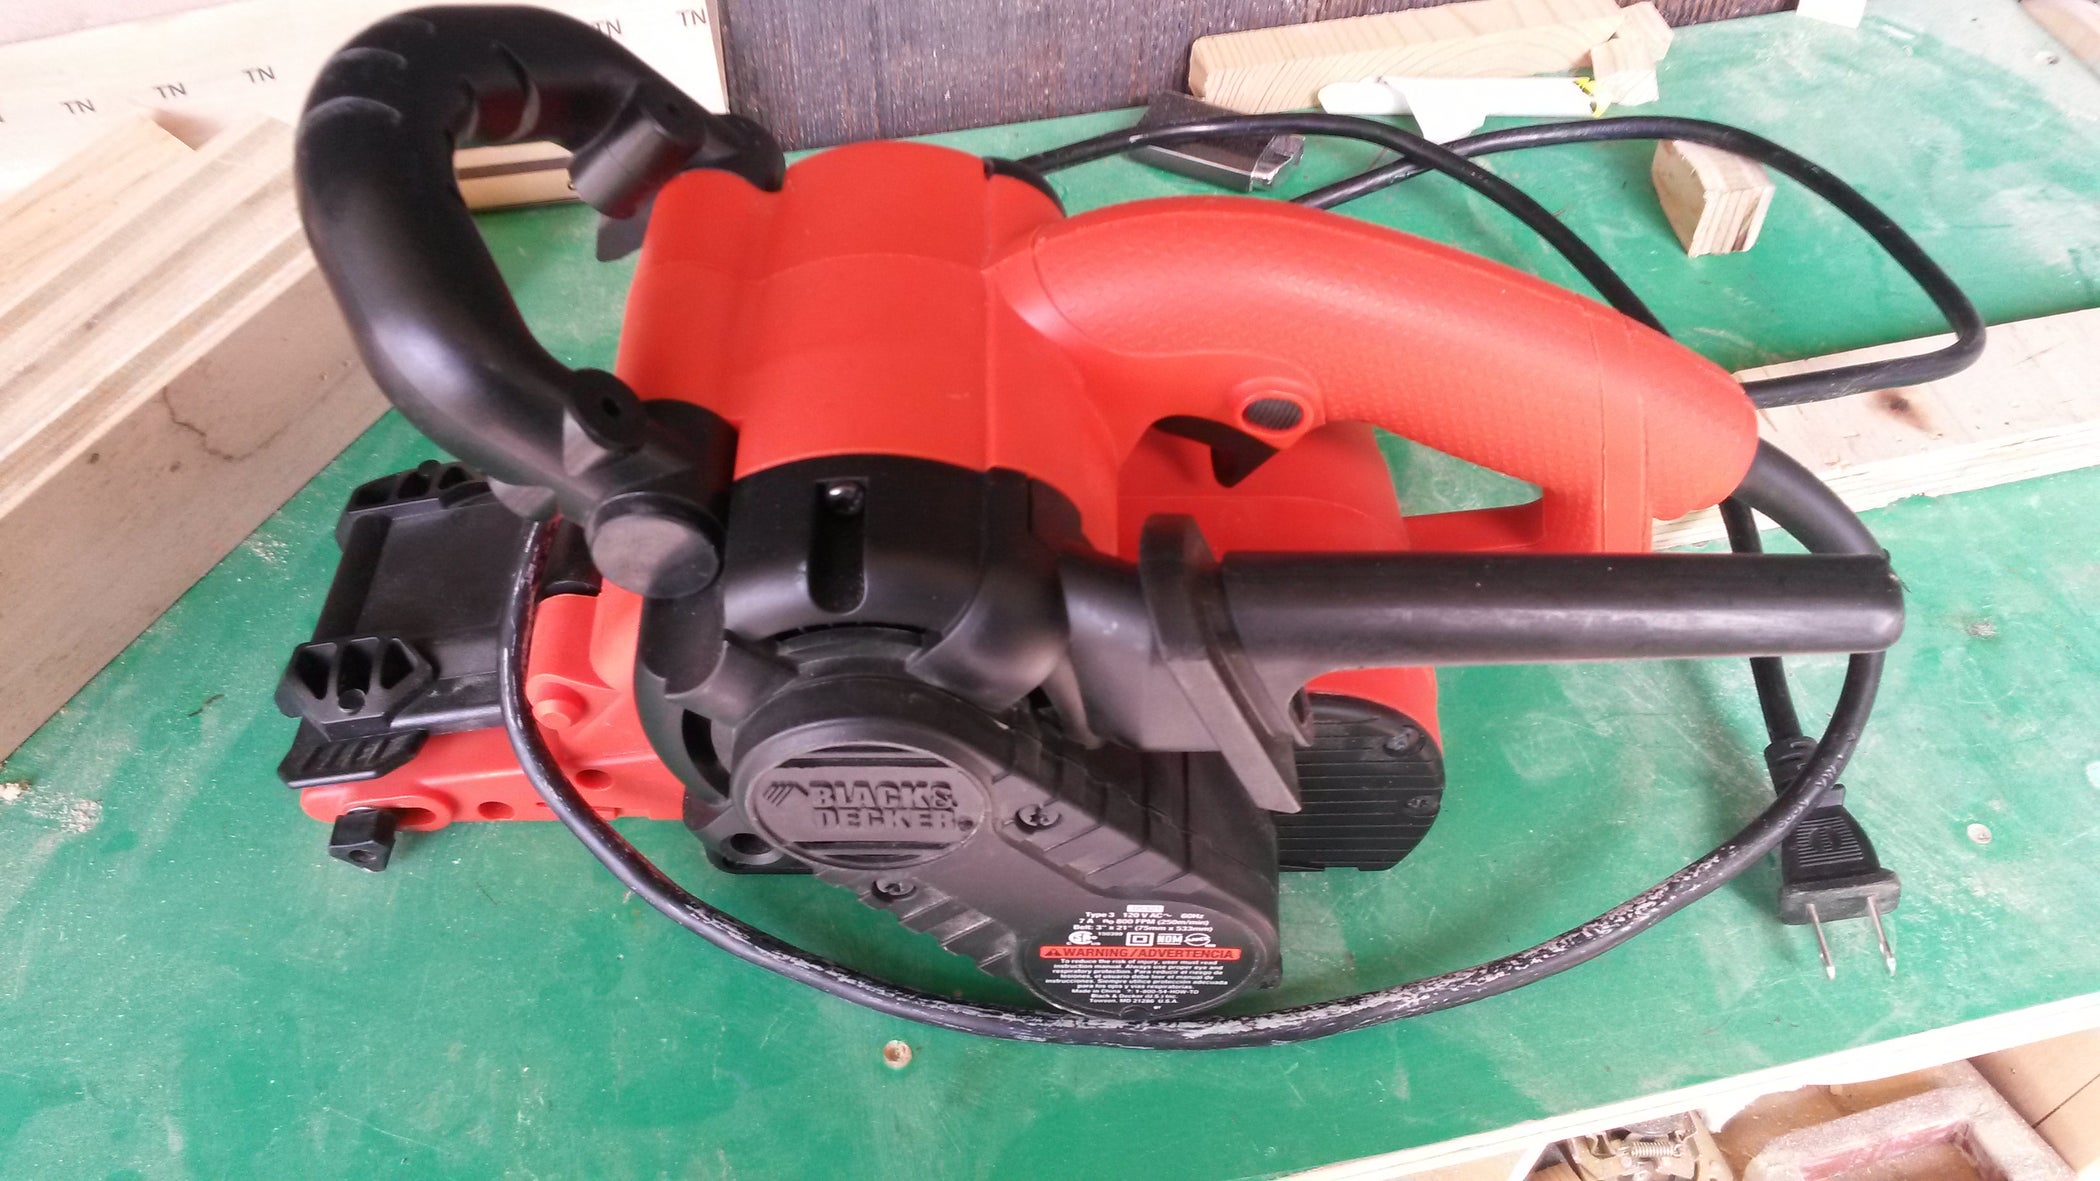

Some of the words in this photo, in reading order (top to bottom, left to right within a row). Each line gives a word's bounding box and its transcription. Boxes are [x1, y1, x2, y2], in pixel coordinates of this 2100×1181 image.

[677, 9, 706, 26] TN
[243, 66, 275, 83] TN
[154, 83, 187, 98] TN
[62, 99, 96, 114] TN
[814, 808, 957, 829] DECKER
